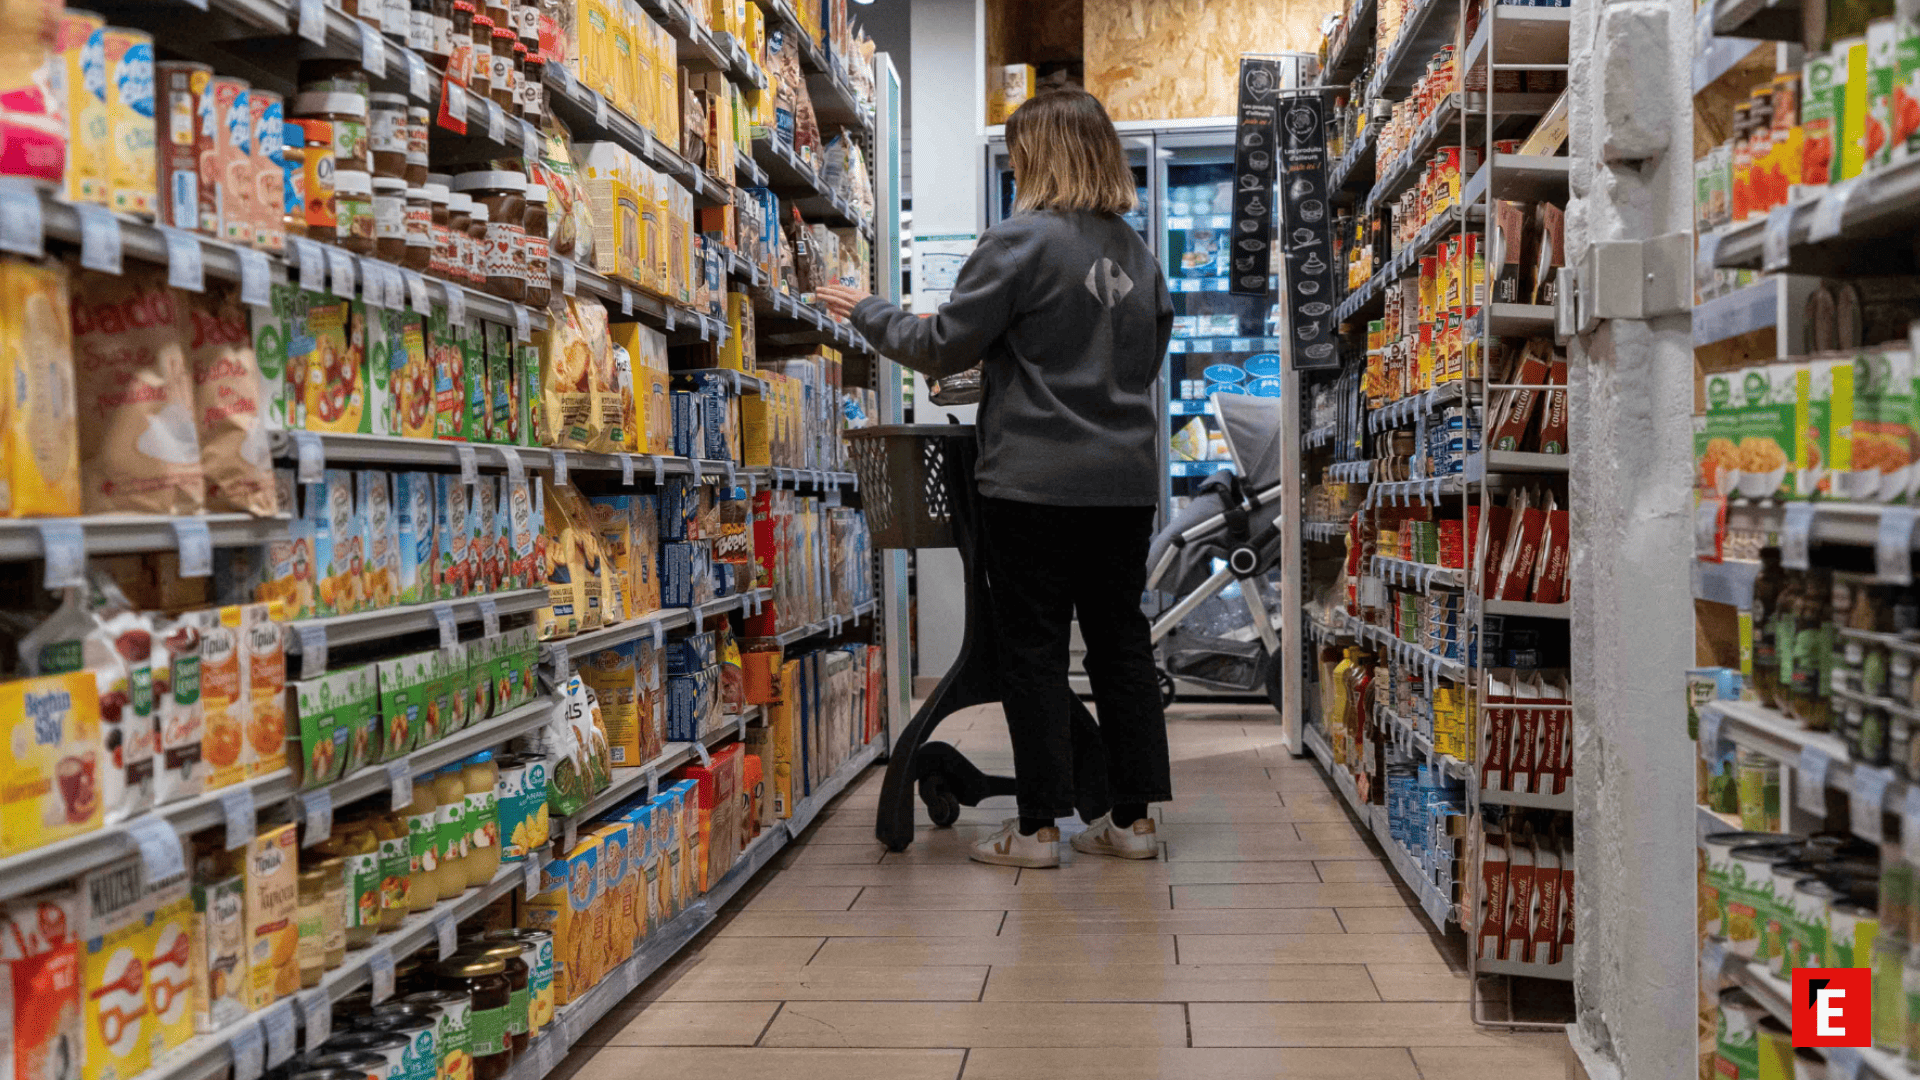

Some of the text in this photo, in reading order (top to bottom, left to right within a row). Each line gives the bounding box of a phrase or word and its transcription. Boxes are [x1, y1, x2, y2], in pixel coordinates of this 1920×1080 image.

[1296, 146, 1322, 154] produits
[1511, 389, 1530, 424] couscou
[1551, 390, 1562, 428] couscou
[1489, 893, 1499, 922] Poulet
[1515, 897, 1524, 926] Poulet
[1541, 899, 1551, 930] Poulet
